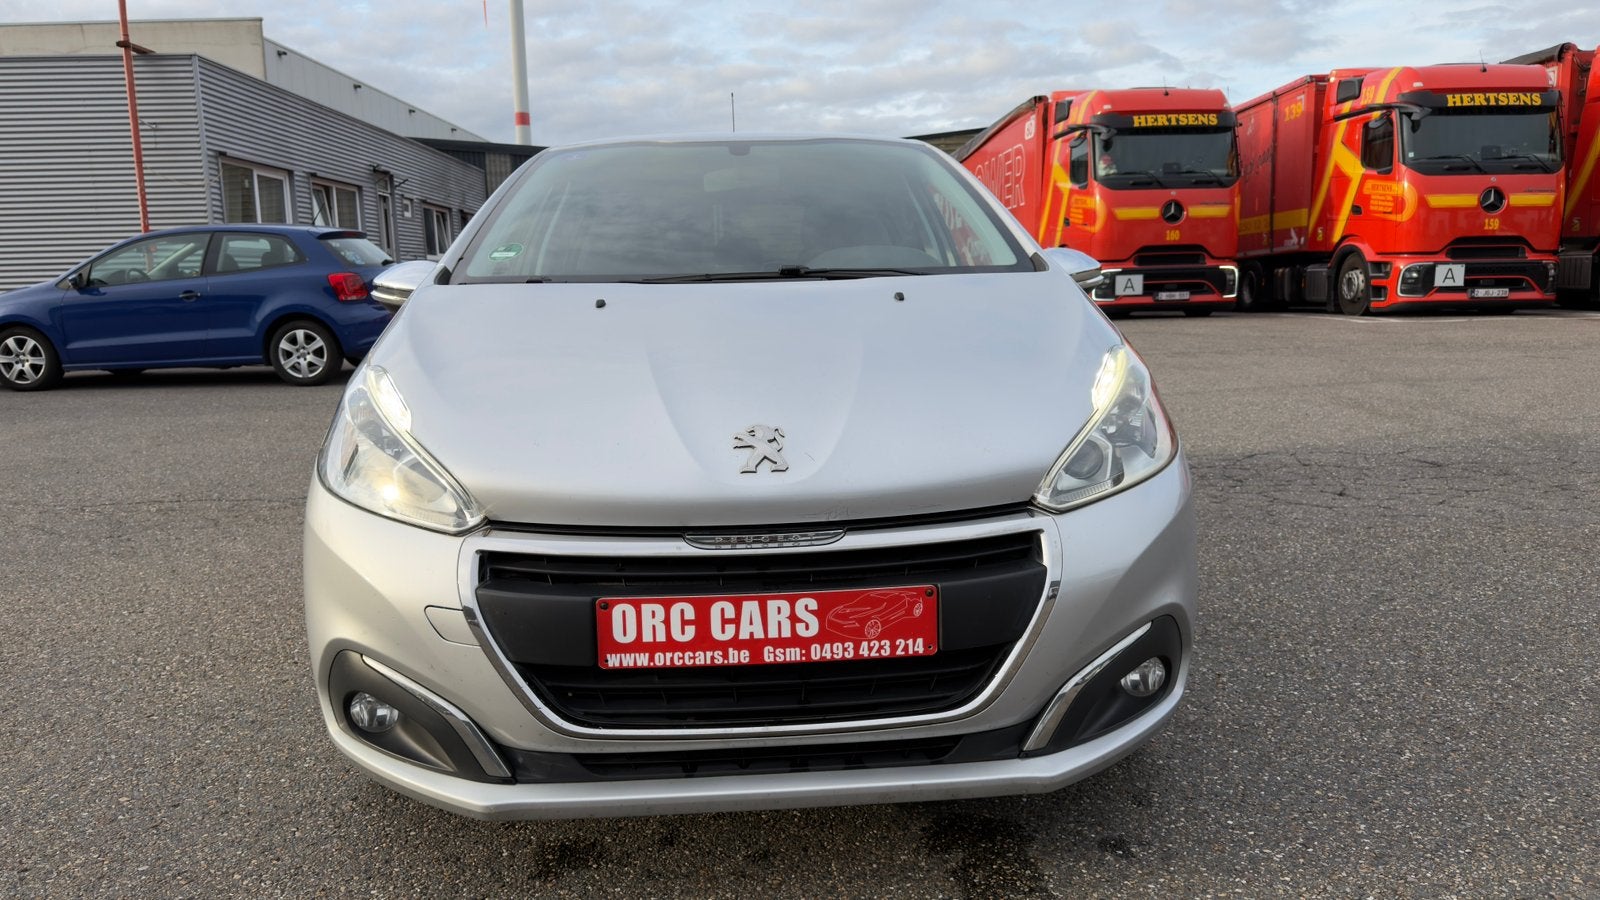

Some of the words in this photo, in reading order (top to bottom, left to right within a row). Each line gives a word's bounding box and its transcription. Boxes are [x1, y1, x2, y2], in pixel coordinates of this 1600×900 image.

[1446, 93, 1542, 106] HERTSENS
[1284, 101, 1303, 122] 139
[1132, 113, 1218, 127] HERTSENS
[1484, 218, 1500, 230] 159
[1165, 229, 1181, 241] 160
[1442, 267, 1456, 284] A
[1122, 277, 1136, 293] A
[611, 602, 696, 644] ORC
[710, 597, 820, 641] CARS
[606, 647, 750, 667] www.orccars.be
[763, 645, 806, 662] Gsm:
[810, 641, 855, 661] 0493
[859, 638, 892, 657] 423
[895, 637, 925, 656] 214
